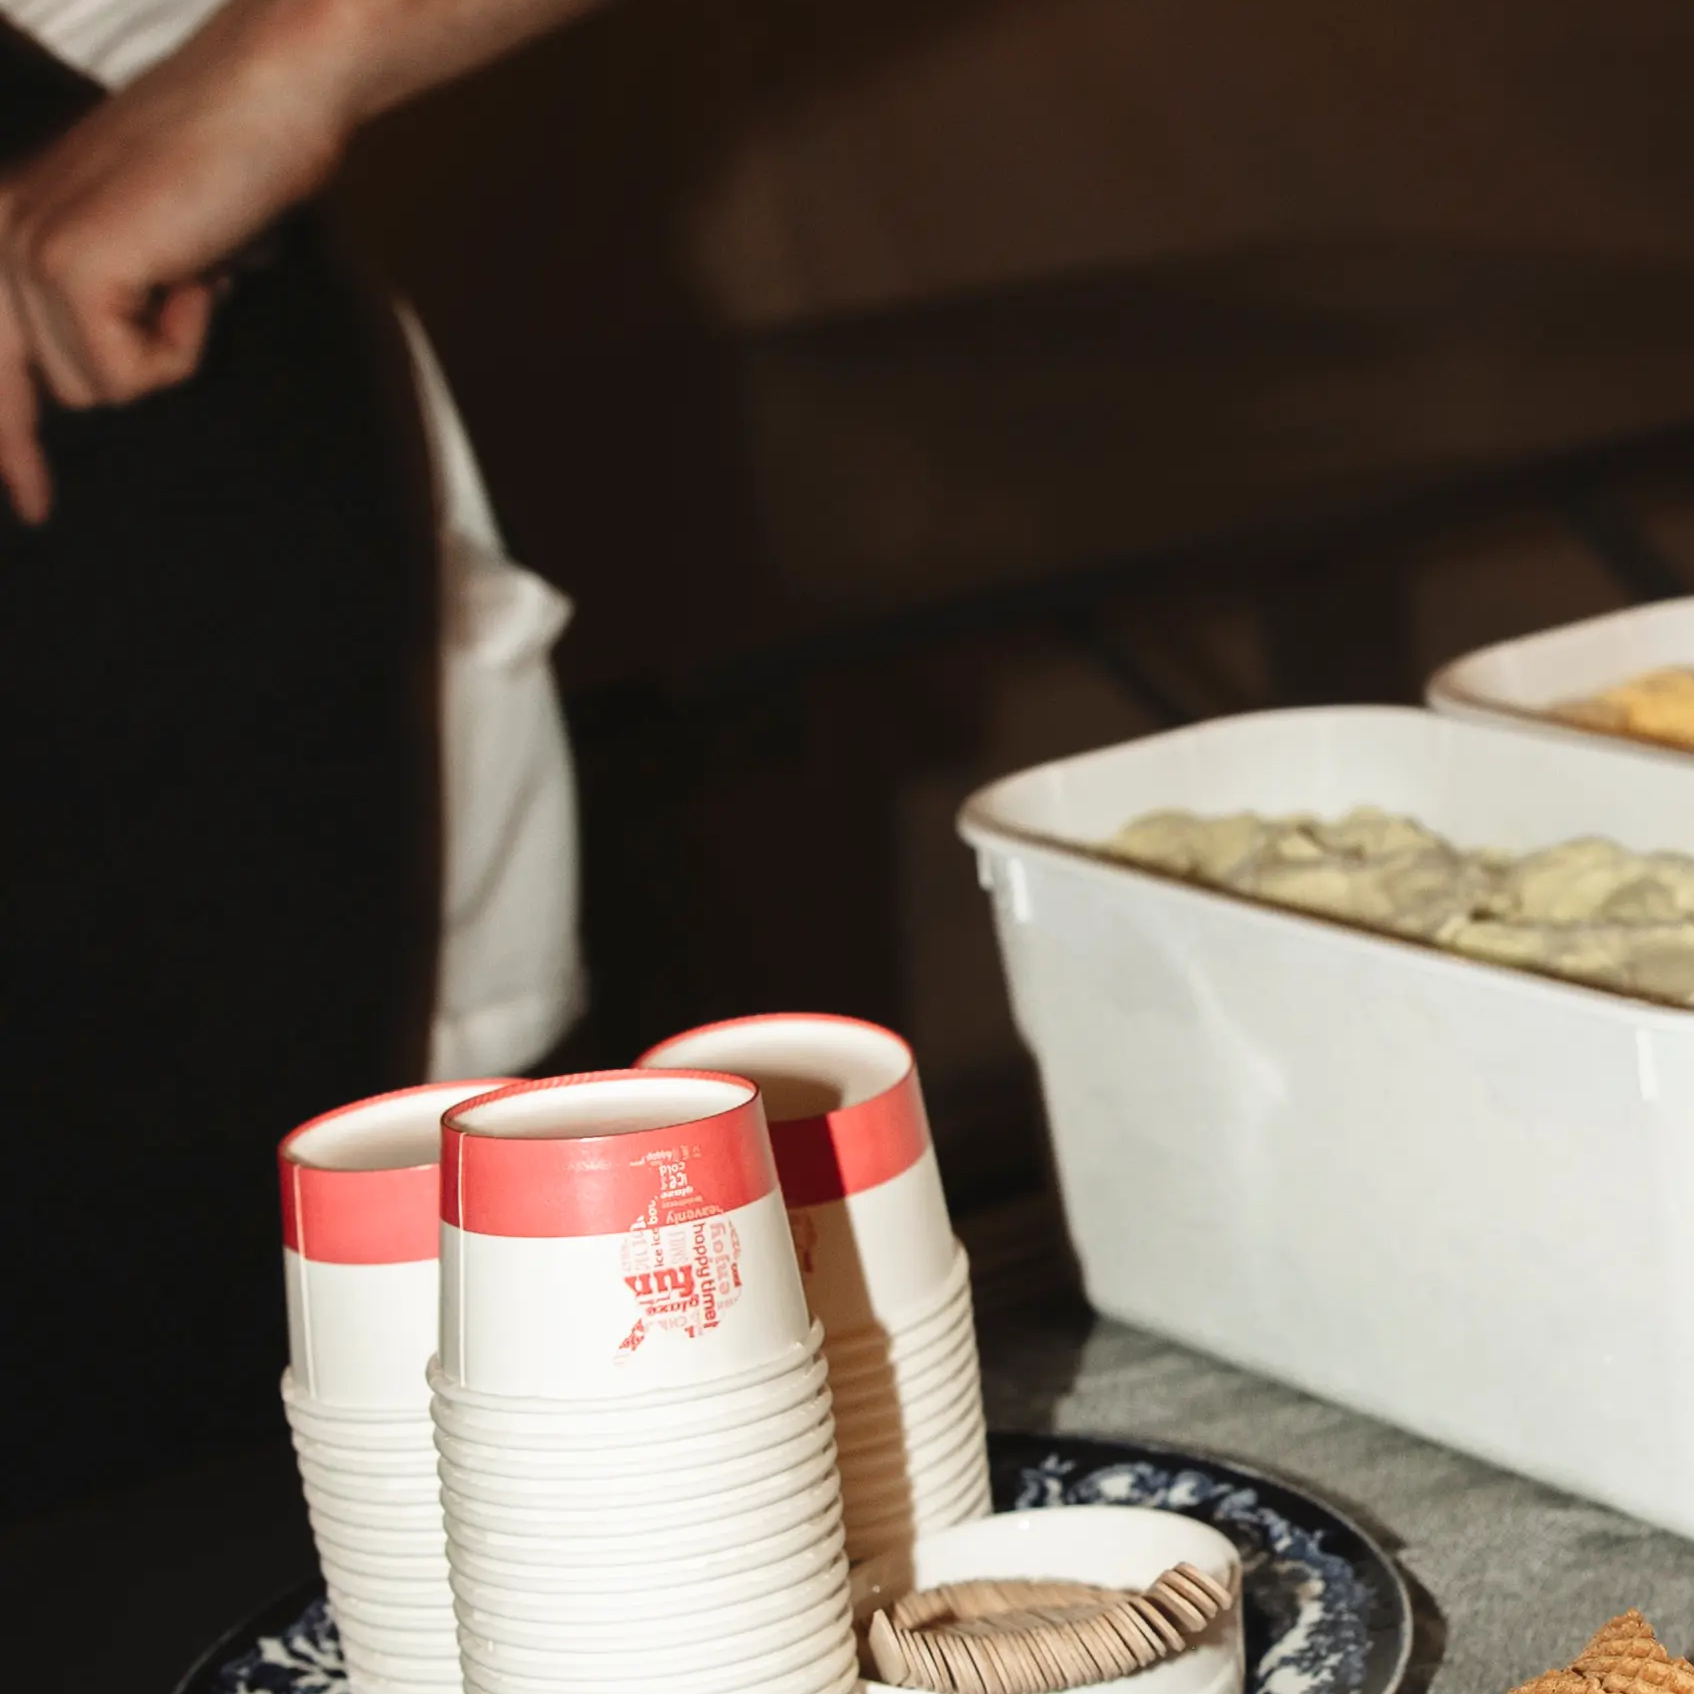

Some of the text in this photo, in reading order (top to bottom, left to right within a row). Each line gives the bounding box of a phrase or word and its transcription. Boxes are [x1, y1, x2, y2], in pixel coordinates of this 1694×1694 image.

[659, 1161, 686, 1178] cold
[693, 1221, 711, 1278] happy
[710, 1222, 731, 1295] enjoy
[624, 1264, 695, 1297] fun
